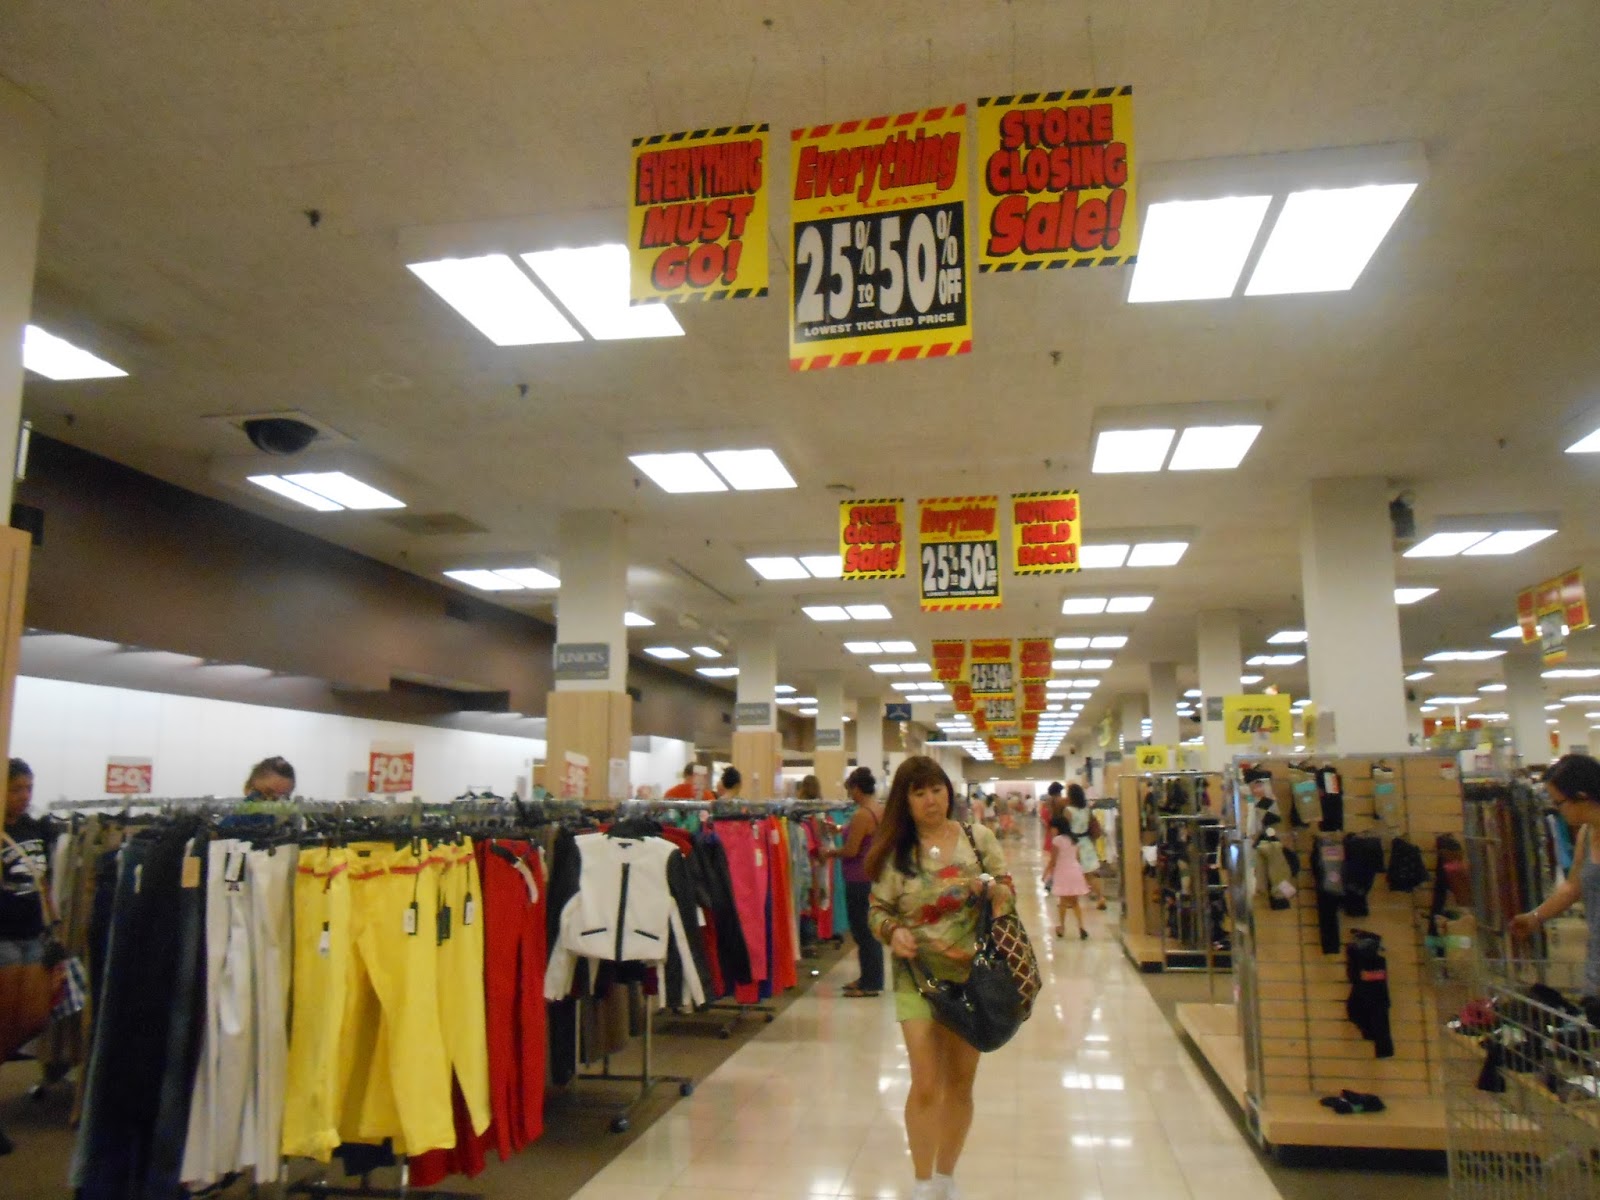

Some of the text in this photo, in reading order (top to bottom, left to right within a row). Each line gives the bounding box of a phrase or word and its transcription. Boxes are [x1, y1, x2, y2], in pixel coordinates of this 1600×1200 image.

[1000, 104, 1113, 151] STORE
[637, 140, 763, 206] EVERYTHING
[795, 131, 961, 202] Everything
[987, 142, 1127, 195] CLOSING
[640, 195, 754, 248] MUST
[818, 192, 942, 214] AT LEAST
[987, 189, 1126, 257] Sale!
[652, 241, 742, 289] GO!
[939, 268, 962, 305] OFF
[805, 312, 955, 337] LOWEST TICKETED PRICE
[844, 543, 901, 571] Sale!
